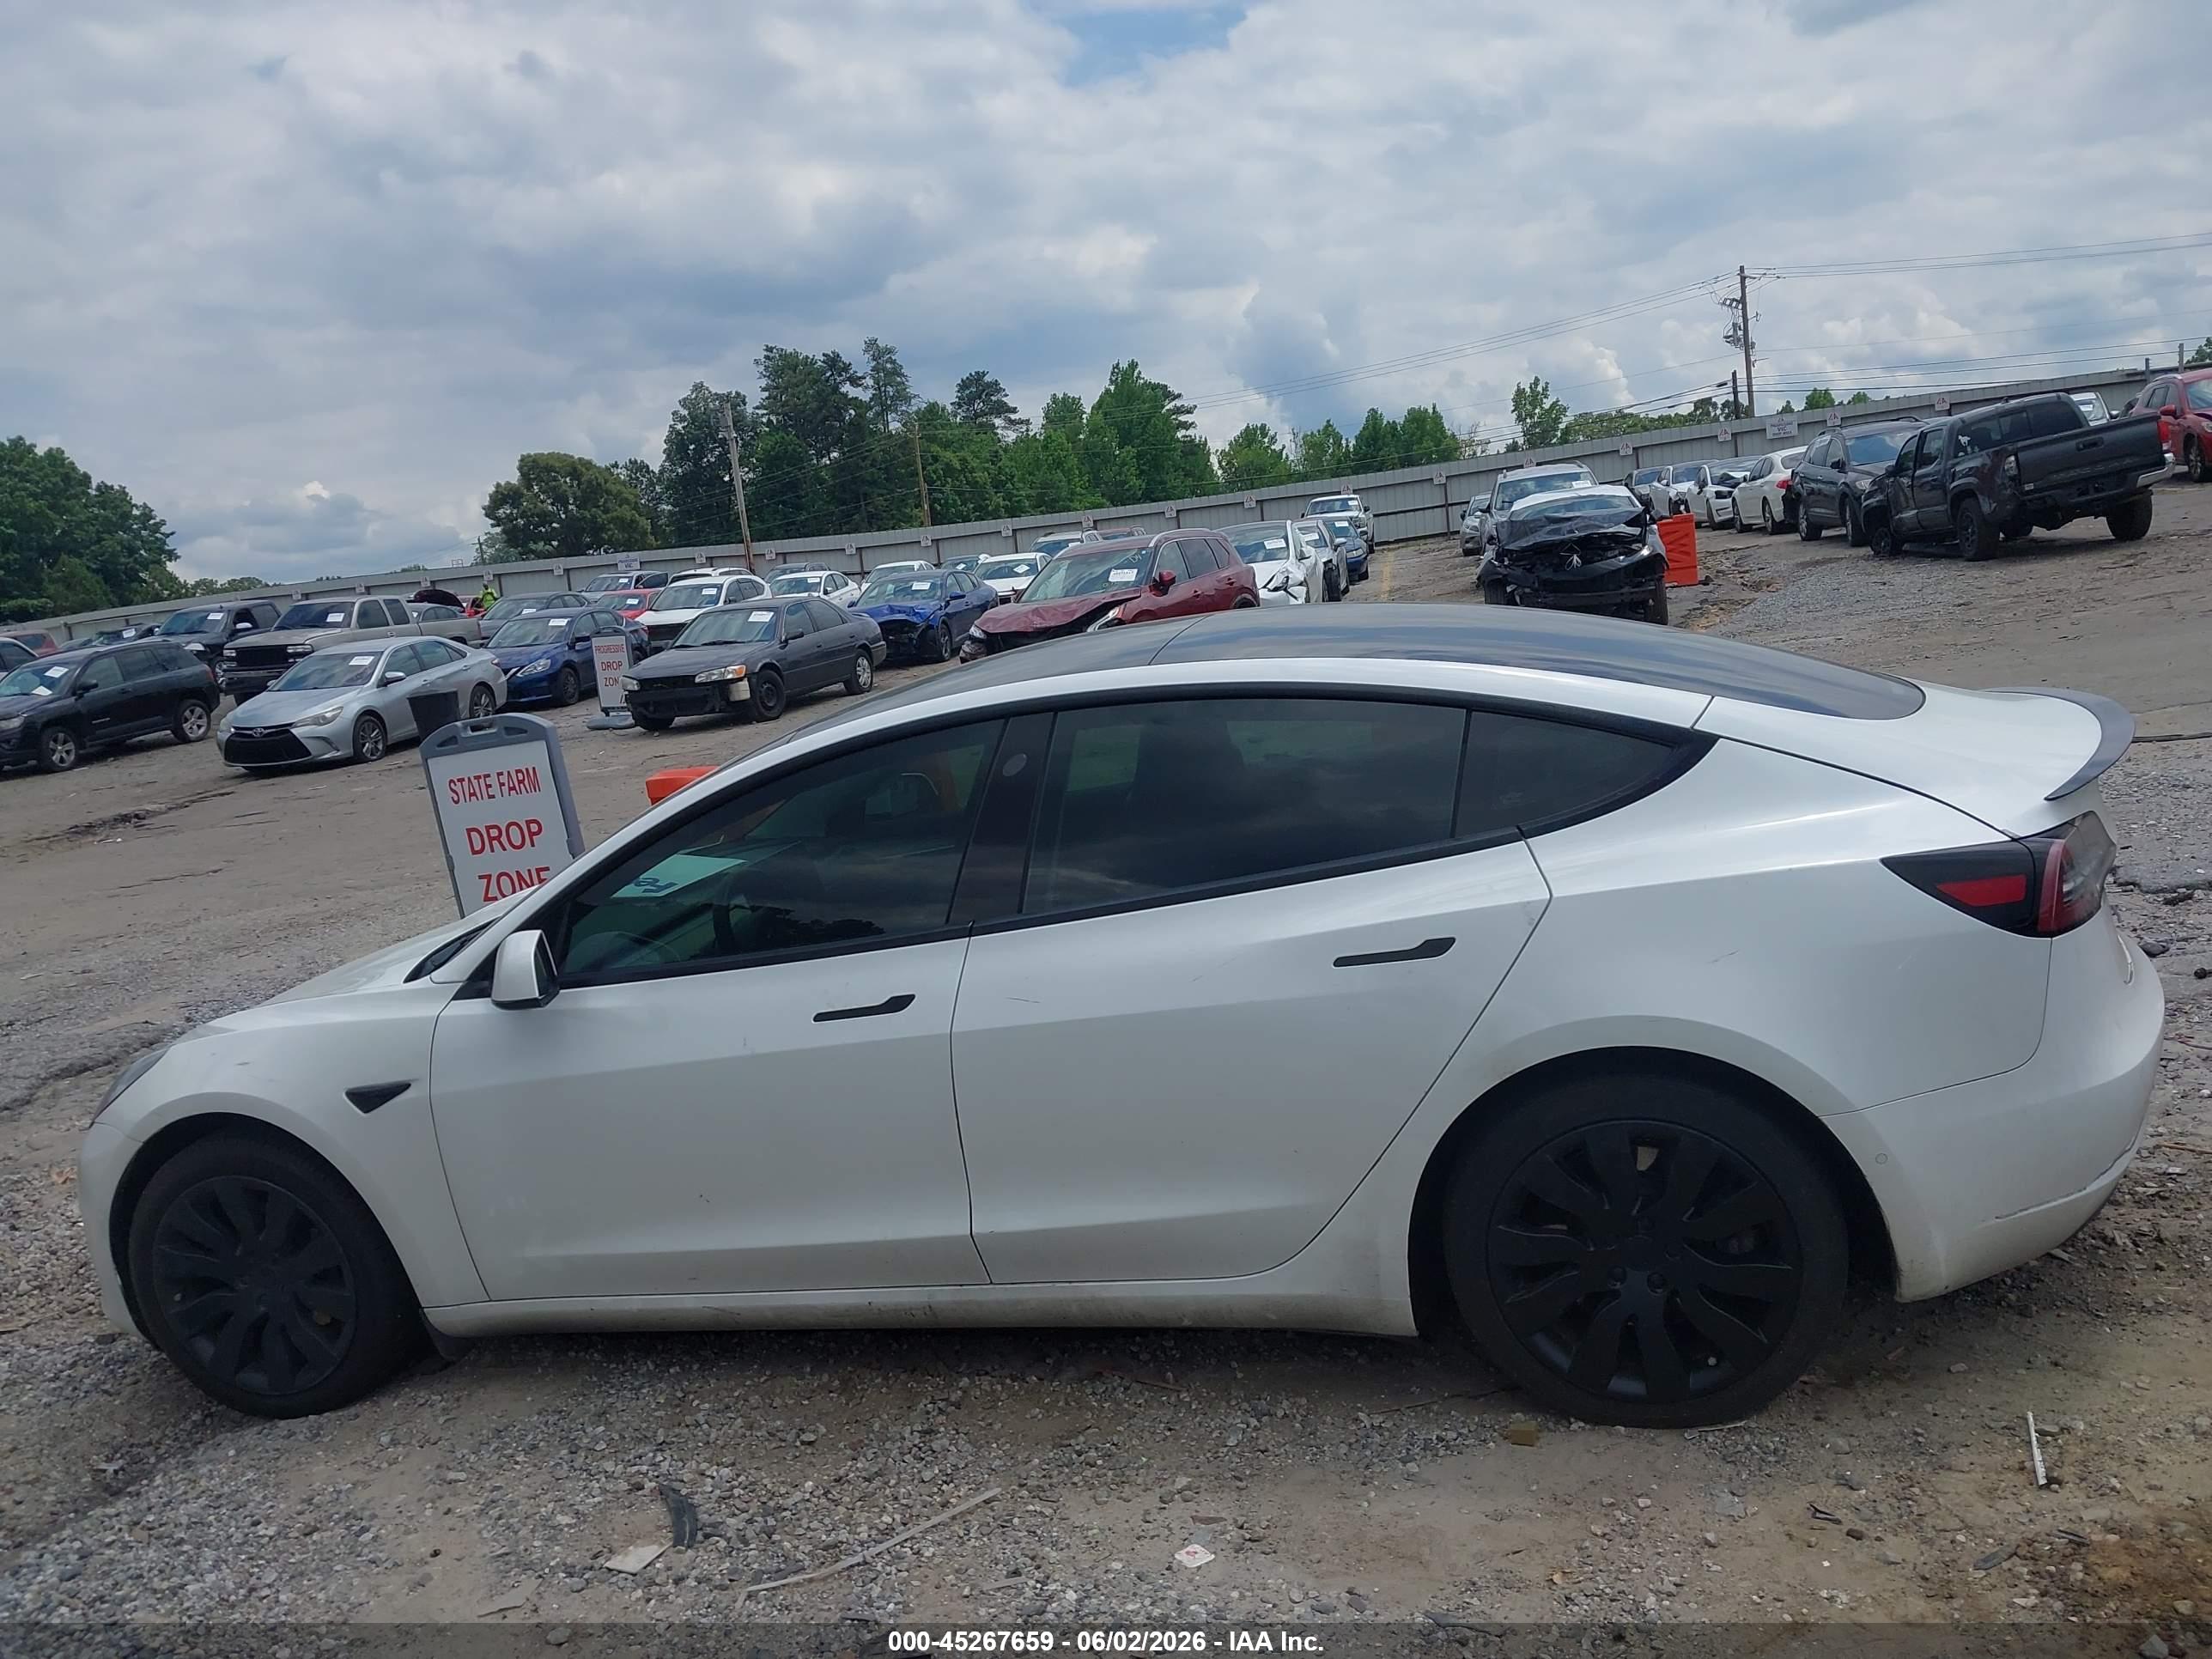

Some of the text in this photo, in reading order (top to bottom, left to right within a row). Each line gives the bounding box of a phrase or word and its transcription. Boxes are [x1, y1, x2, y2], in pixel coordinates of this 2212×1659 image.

[601, 660, 623, 672] DROP
[605, 677, 619, 687] ZON
[448, 767, 541, 805] STATE FARM
[465, 819, 543, 855] DROP
